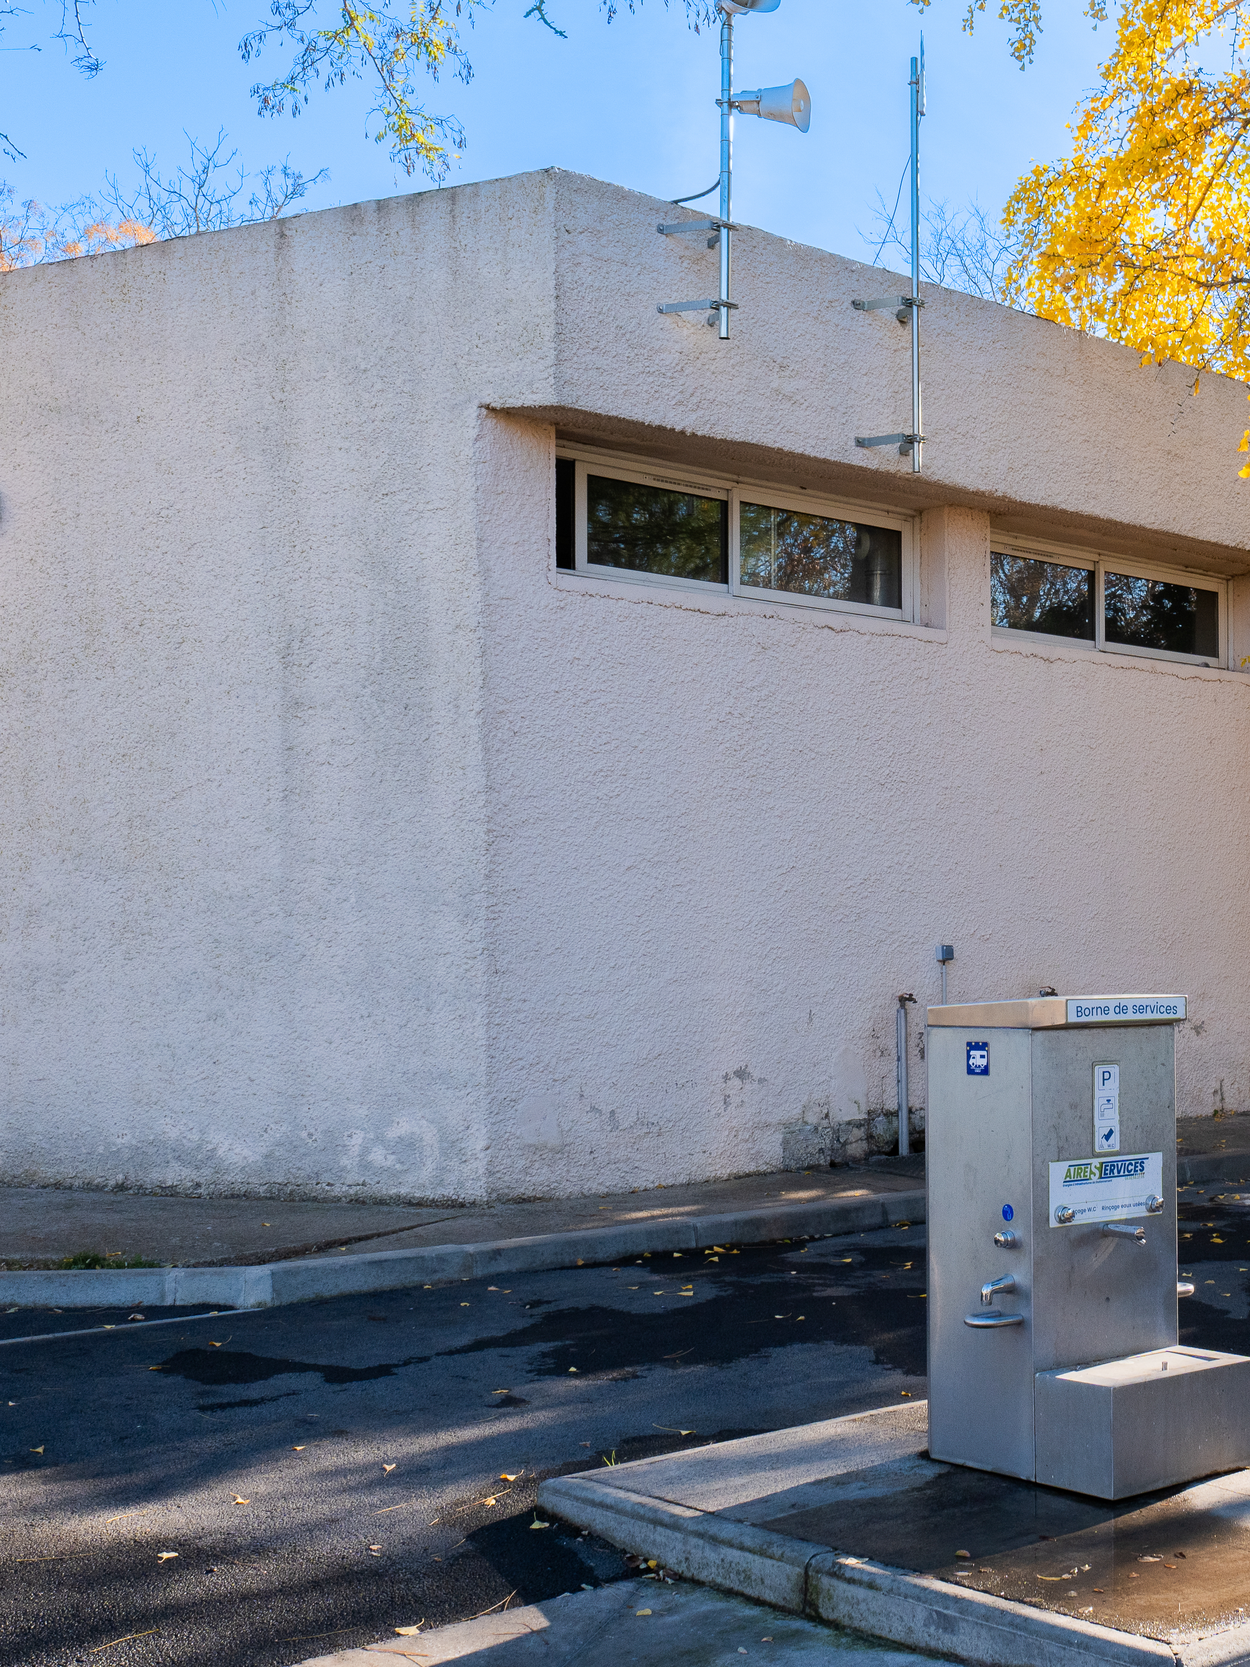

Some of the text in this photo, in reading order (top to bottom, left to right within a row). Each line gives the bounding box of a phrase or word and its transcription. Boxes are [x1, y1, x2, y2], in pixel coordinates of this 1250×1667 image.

[1076, 1001, 1178, 1018] Borne de services
[1102, 1070, 1111, 1086] P
[1101, 1204, 1120, 1212] Rinçage
